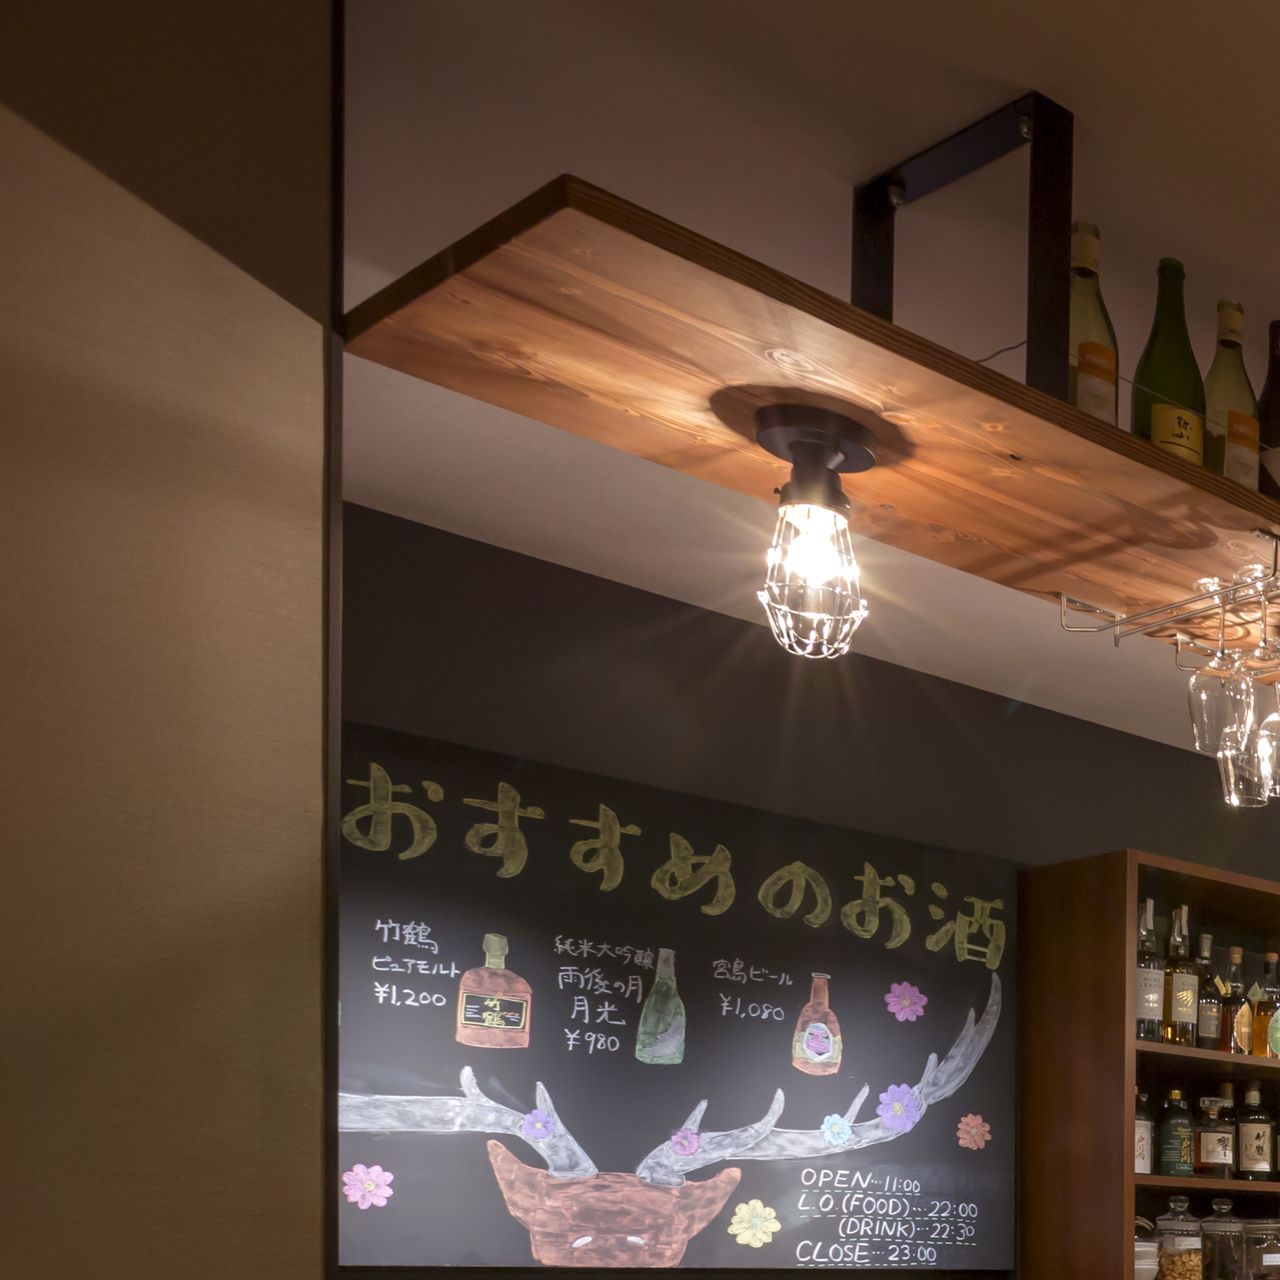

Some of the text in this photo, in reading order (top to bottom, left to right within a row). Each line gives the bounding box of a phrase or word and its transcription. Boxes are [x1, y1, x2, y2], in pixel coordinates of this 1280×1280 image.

[341, 762, 1007, 970] おすすめのお酒
[375, 919, 439, 954] 竹鶴
[554, 935, 656, 971] 純米大吟醸
[371, 956, 461, 978] ピュアモルト
[712, 957, 793, 986] 宮島ビール
[374, 982, 447, 1007] ¥1,200
[558, 966, 643, 1004] 雨後の月
[570, 996, 626, 1026] 月光
[719, 993, 785, 1021] ¥1,080
[564, 1028, 620, 1054] ¥980
[801, 1168, 921, 1193] OPEN 11:00
[928, 1200, 978, 1218] 22:00
[838, 1218, 975, 1241] (DRINK) 22:30
[796, 1240, 937, 1263] CLOSE 23:00
